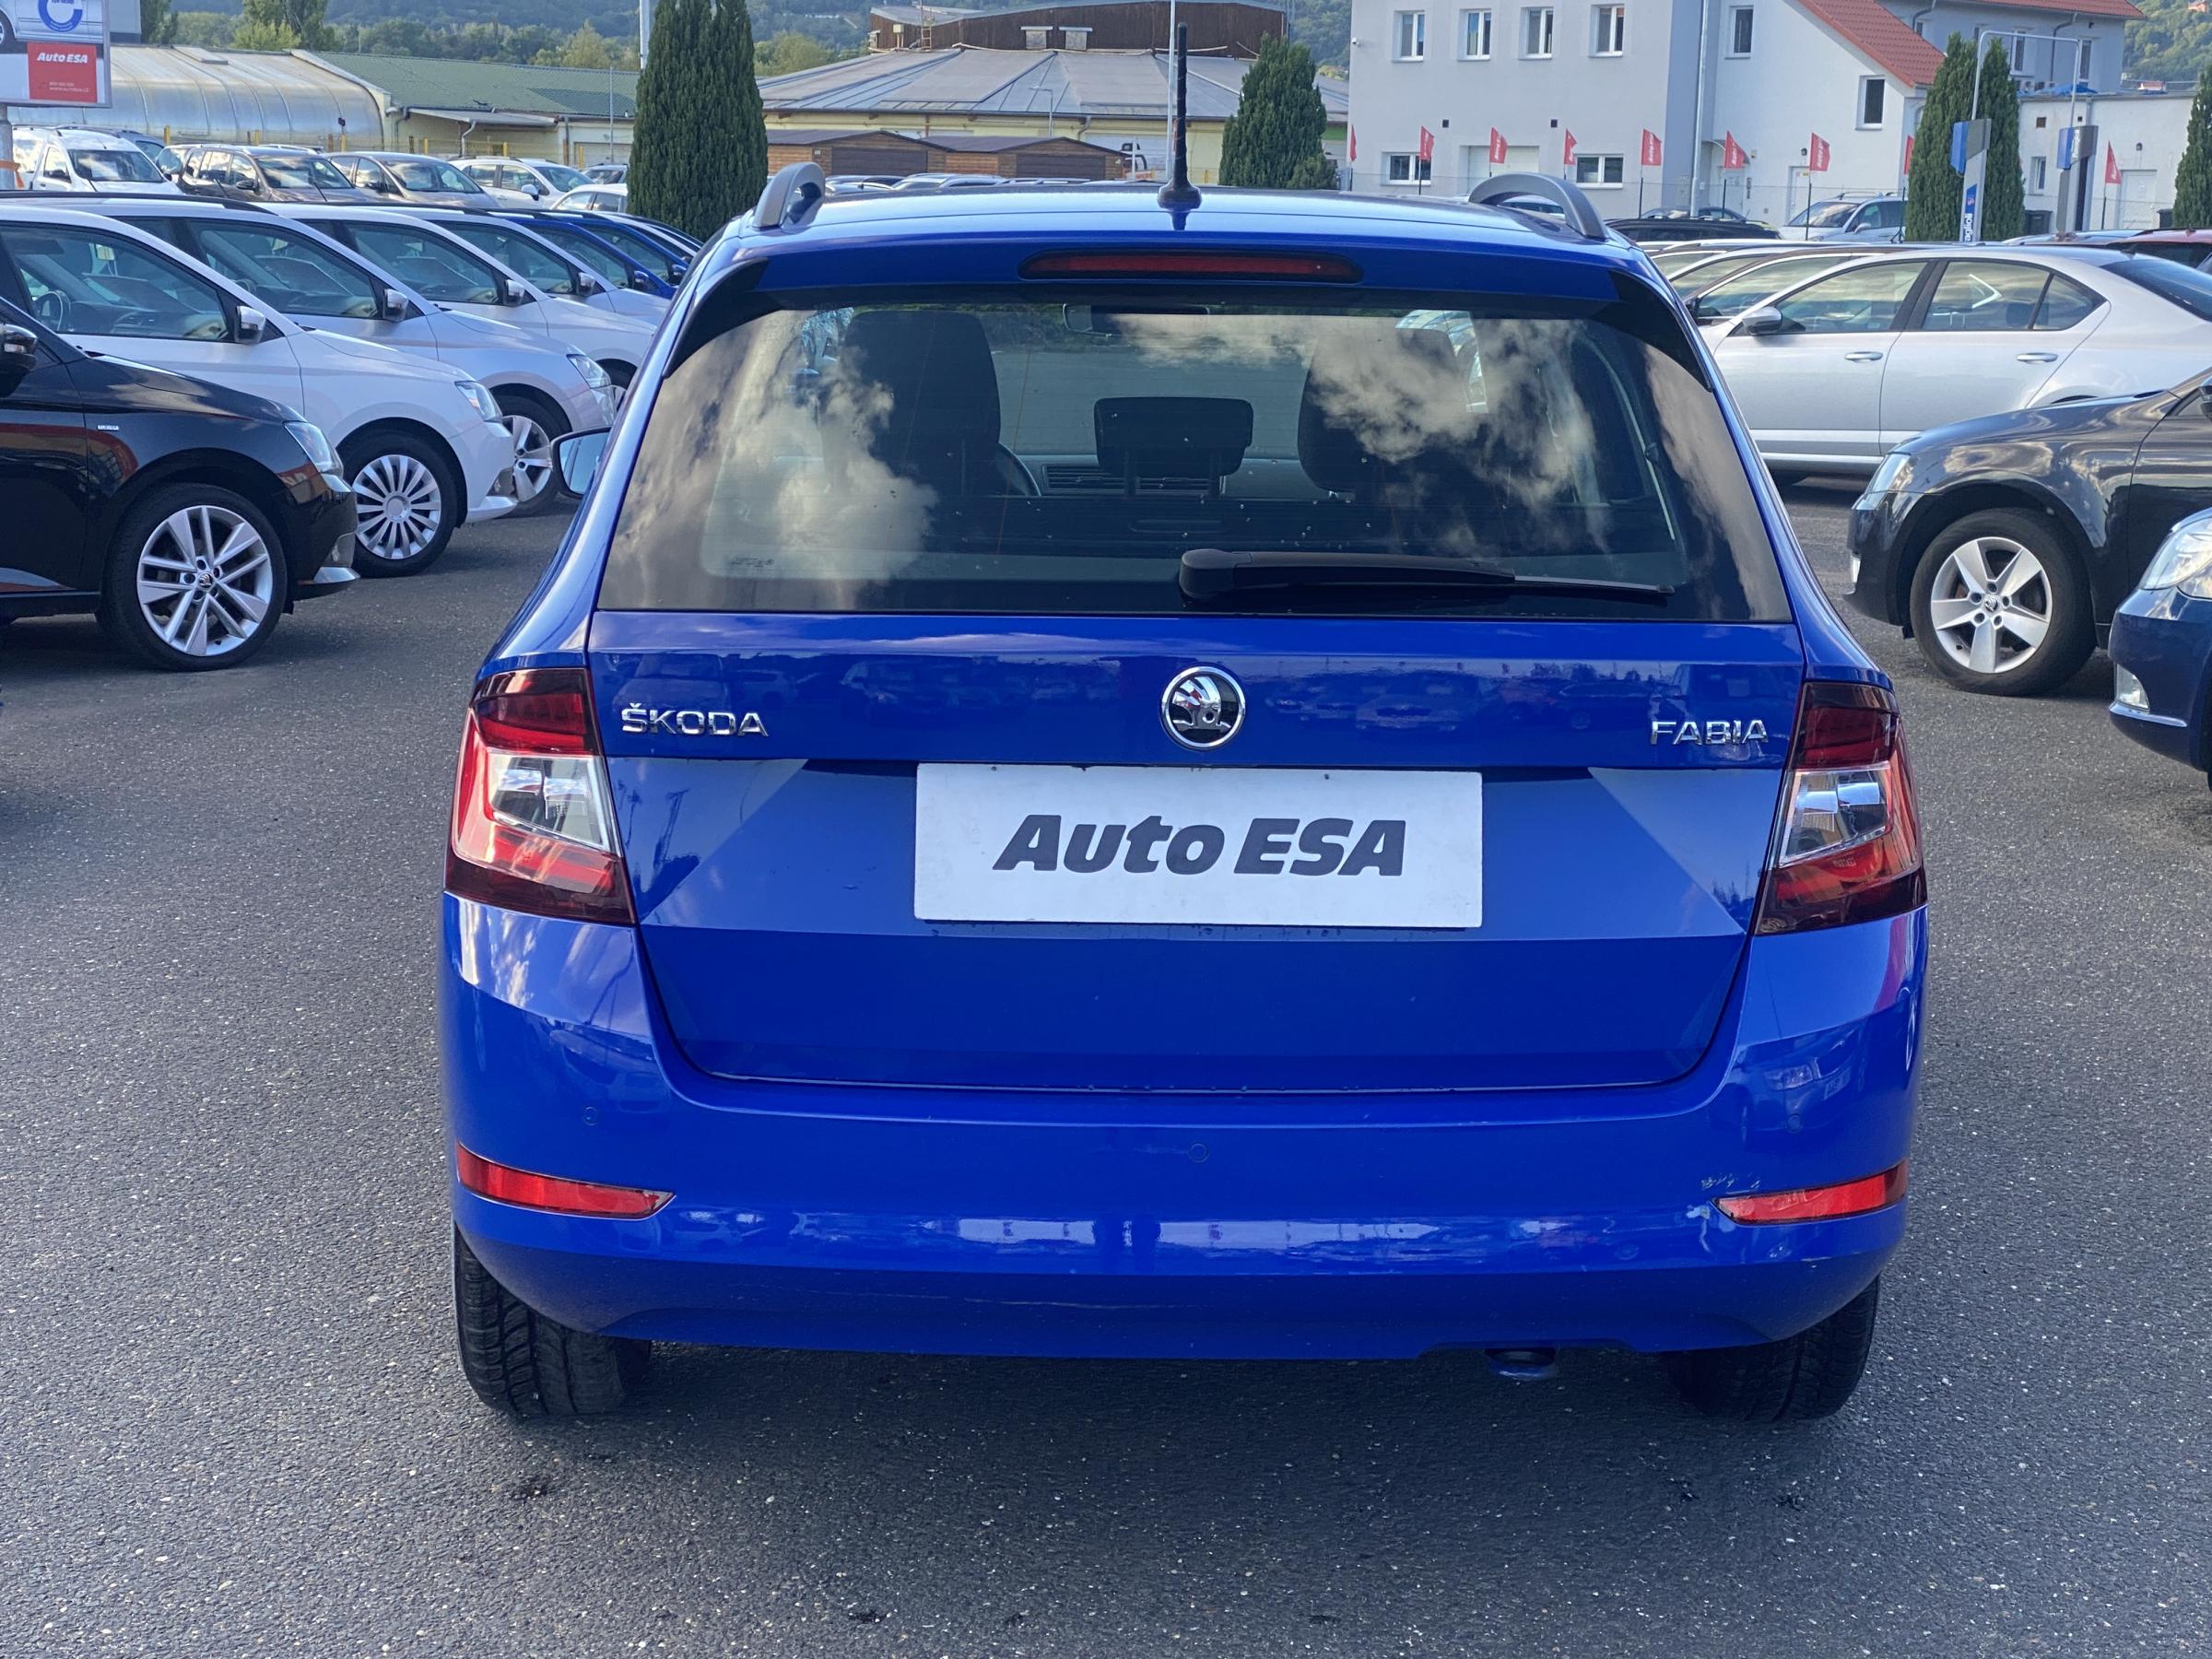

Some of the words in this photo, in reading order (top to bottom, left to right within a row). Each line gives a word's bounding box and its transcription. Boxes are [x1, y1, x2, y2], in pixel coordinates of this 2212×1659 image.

[37, 53, 65, 63] Auto
[66, 53, 88, 64] ESA
[1964, 213, 1973, 241] aglioli
[621, 702, 769, 736] ŠKODA
[1650, 719, 1769, 746] FABIA
[993, 815, 1225, 875] Auto
[1234, 818, 1406, 877] ESA
